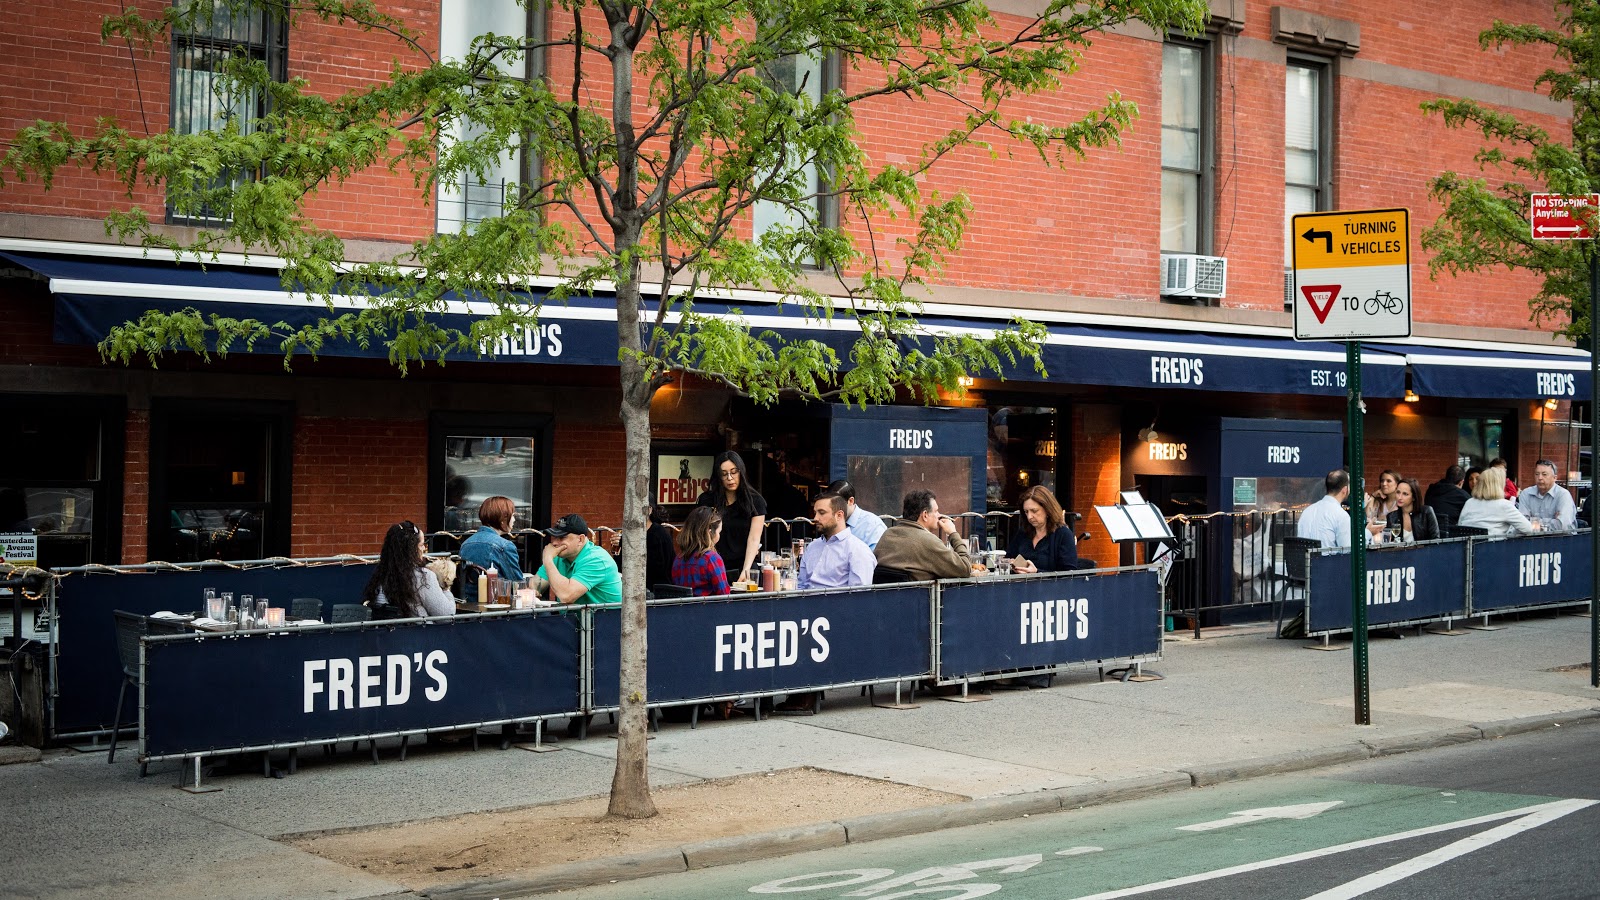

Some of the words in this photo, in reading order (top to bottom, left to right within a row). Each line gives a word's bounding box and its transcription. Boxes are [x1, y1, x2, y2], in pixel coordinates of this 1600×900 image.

[1535, 198, 1547, 208] NO
[1548, 198, 1588, 208] STOPPING
[1535, 209, 1569, 220] Anytime
[1343, 220, 1397, 236] TURNING
[1341, 240, 1401, 255] VEHICLES
[1341, 296, 1360, 311] TO
[1151, 356, 1204, 386] FRED'S
[1311, 369, 1333, 387] EST.
[1335, 371, 1347, 388] 19
[1536, 372, 1576, 396] FRED'S
[889, 428, 933, 450] FRED'S
[1149, 442, 1188, 461] FRED'S
[1267, 445, 1300, 464] FRED'S
[659, 478, 710, 503] FRED'S
[1519, 551, 1562, 588] FRED'S
[1366, 566, 1416, 606] FRED'S
[1020, 597, 1089, 645] FRED'S
[715, 616, 831, 672] FRED'S
[303, 649, 449, 714] FRED'S
